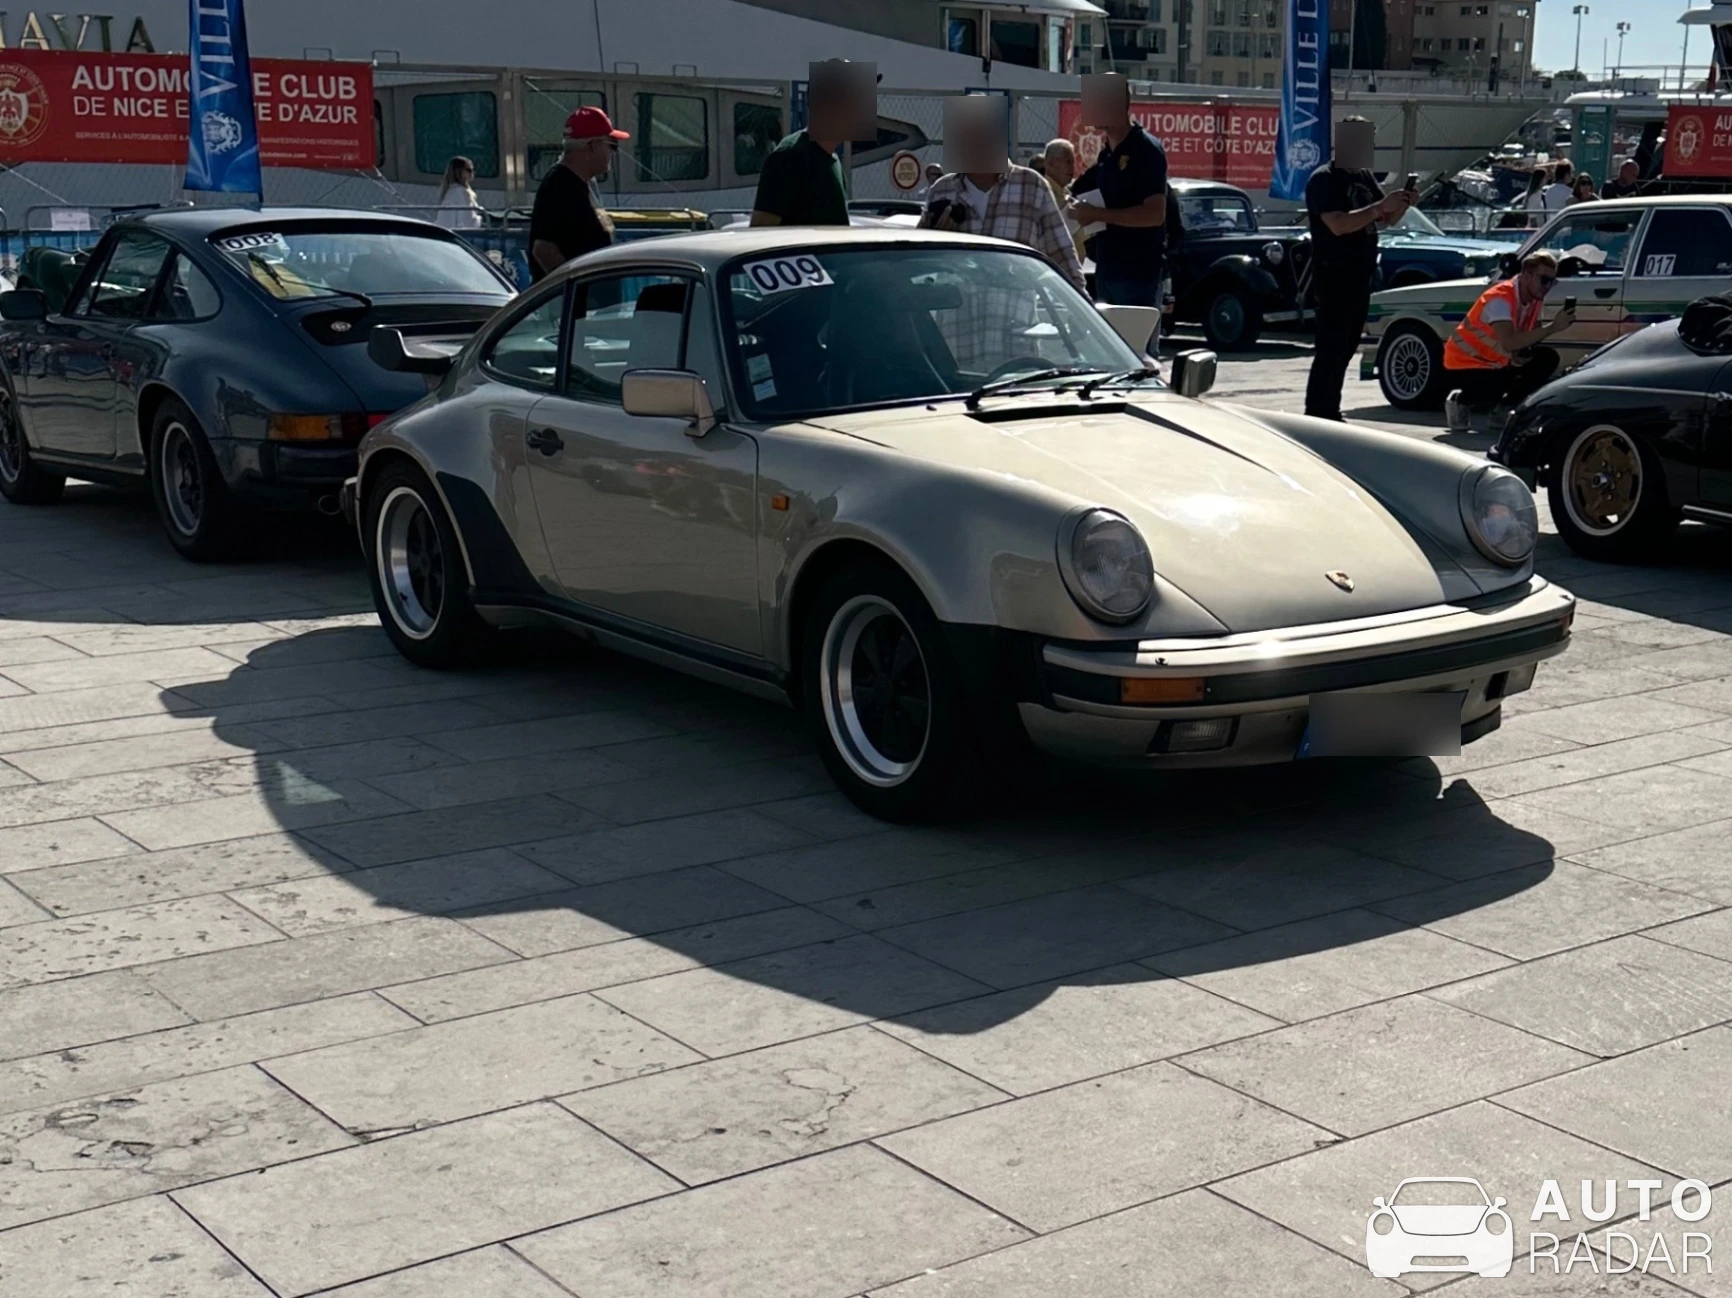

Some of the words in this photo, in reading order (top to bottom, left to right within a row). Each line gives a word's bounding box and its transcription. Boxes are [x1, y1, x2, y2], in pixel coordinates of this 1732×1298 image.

[280, 74, 357, 100] CLUB
[1292, 31, 1319, 131] VILLE
[73, 96, 106, 116] DE
[114, 98, 168, 118] NICE
[176, 99, 190, 119] E
[278, 103, 358, 124] D'AZUR
[1129, 113, 1241, 135] AUTOMOBILE
[1183, 138, 1201, 152] ET
[1204, 136, 1240, 154] CÔTE
[1713, 133, 1727, 147] DE
[225, 233, 279, 249] 008
[751, 257, 824, 291] 009
[1646, 256, 1675, 275] 017
